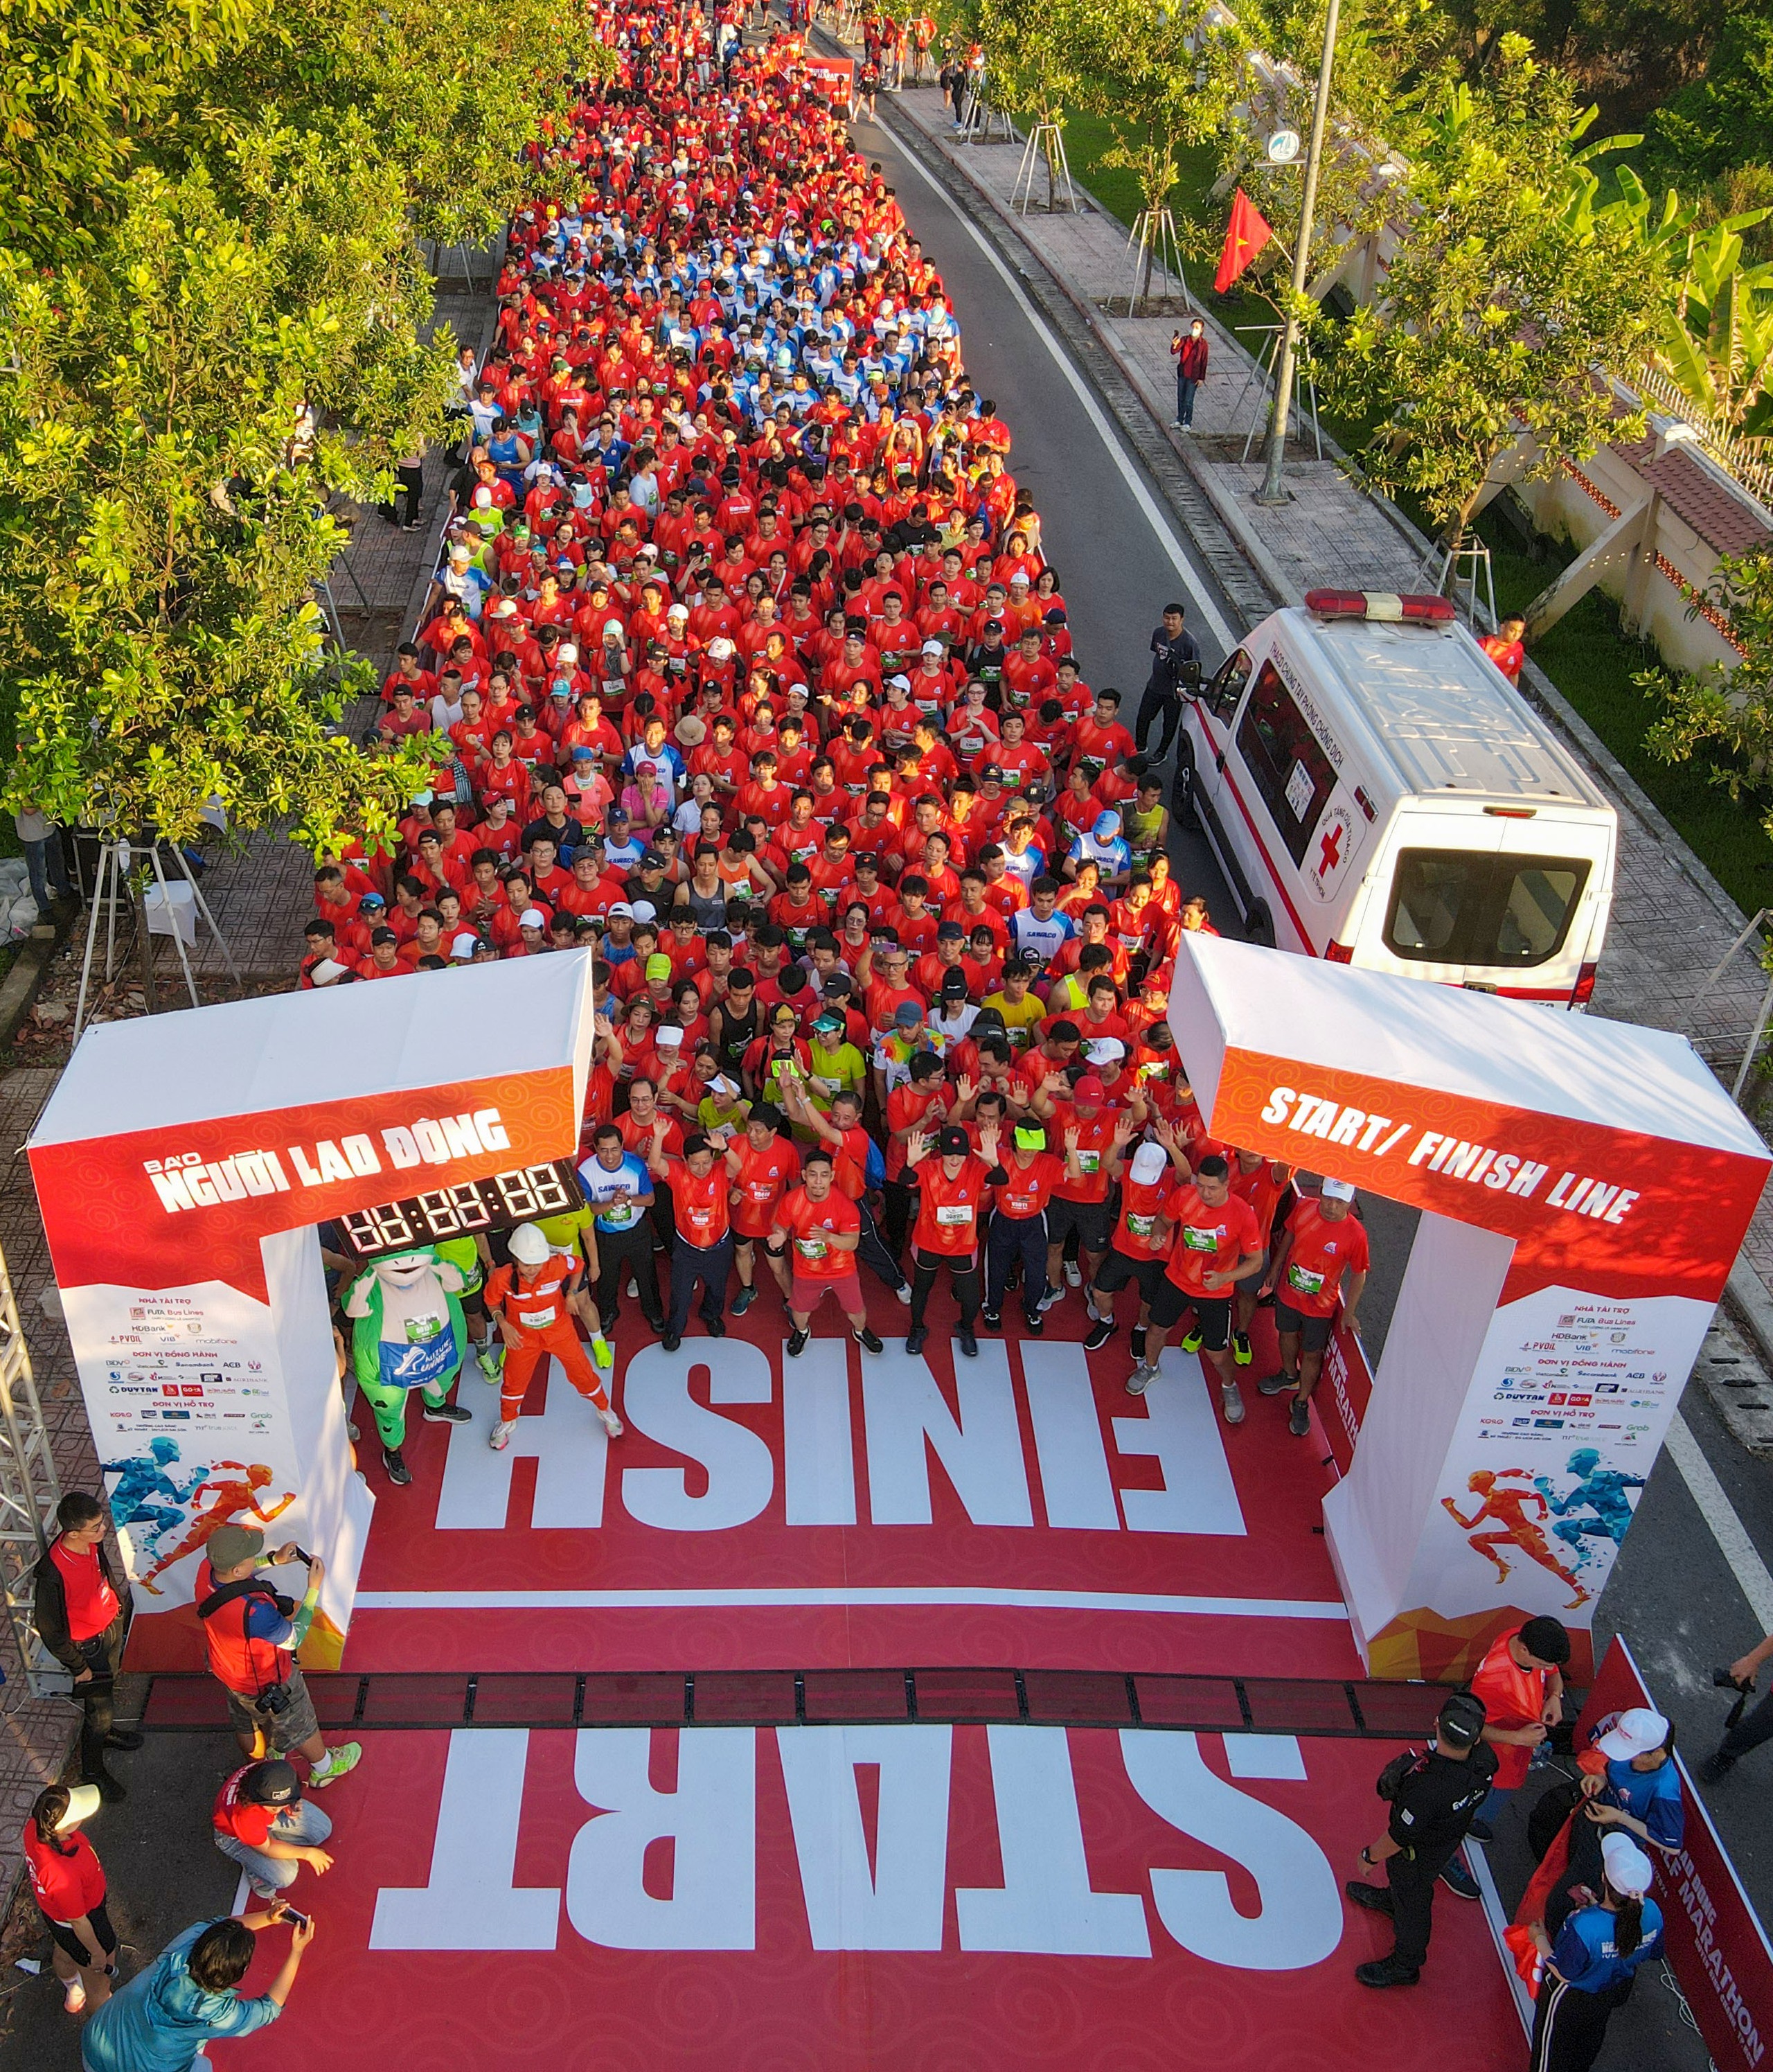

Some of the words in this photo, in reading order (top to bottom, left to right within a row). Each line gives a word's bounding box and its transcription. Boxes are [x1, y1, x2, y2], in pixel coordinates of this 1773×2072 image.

[1269, 641, 1285, 667] THACO
[1281, 662, 1297, 689] CHUNG
[1293, 682, 1306, 702] TAY
[1301, 695, 1319, 725] PHÒNG
[1315, 719, 1333, 750] CHỐNG
[1330, 743, 1344, 769] DỊCH
[143, 1151, 202, 1174] BÁO
[149, 1149, 291, 1214] NGƯỜI
[287, 1133, 382, 1187] LAO
[380, 1107, 511, 1171] ĐỘNG
[1261, 1086, 1411, 1156] START/
[1407, 1131, 1549, 1198] FINISH
[1545, 1172, 1640, 1225] LINE
[1533, 1342, 1556, 1350] PVOIL
[435, 1336, 1247, 1535] FINISH
[368, 1724, 1344, 1969] START
[1679, 1850, 1695, 1879] AO
[1678, 1879, 1765, 2063] MARATHON
